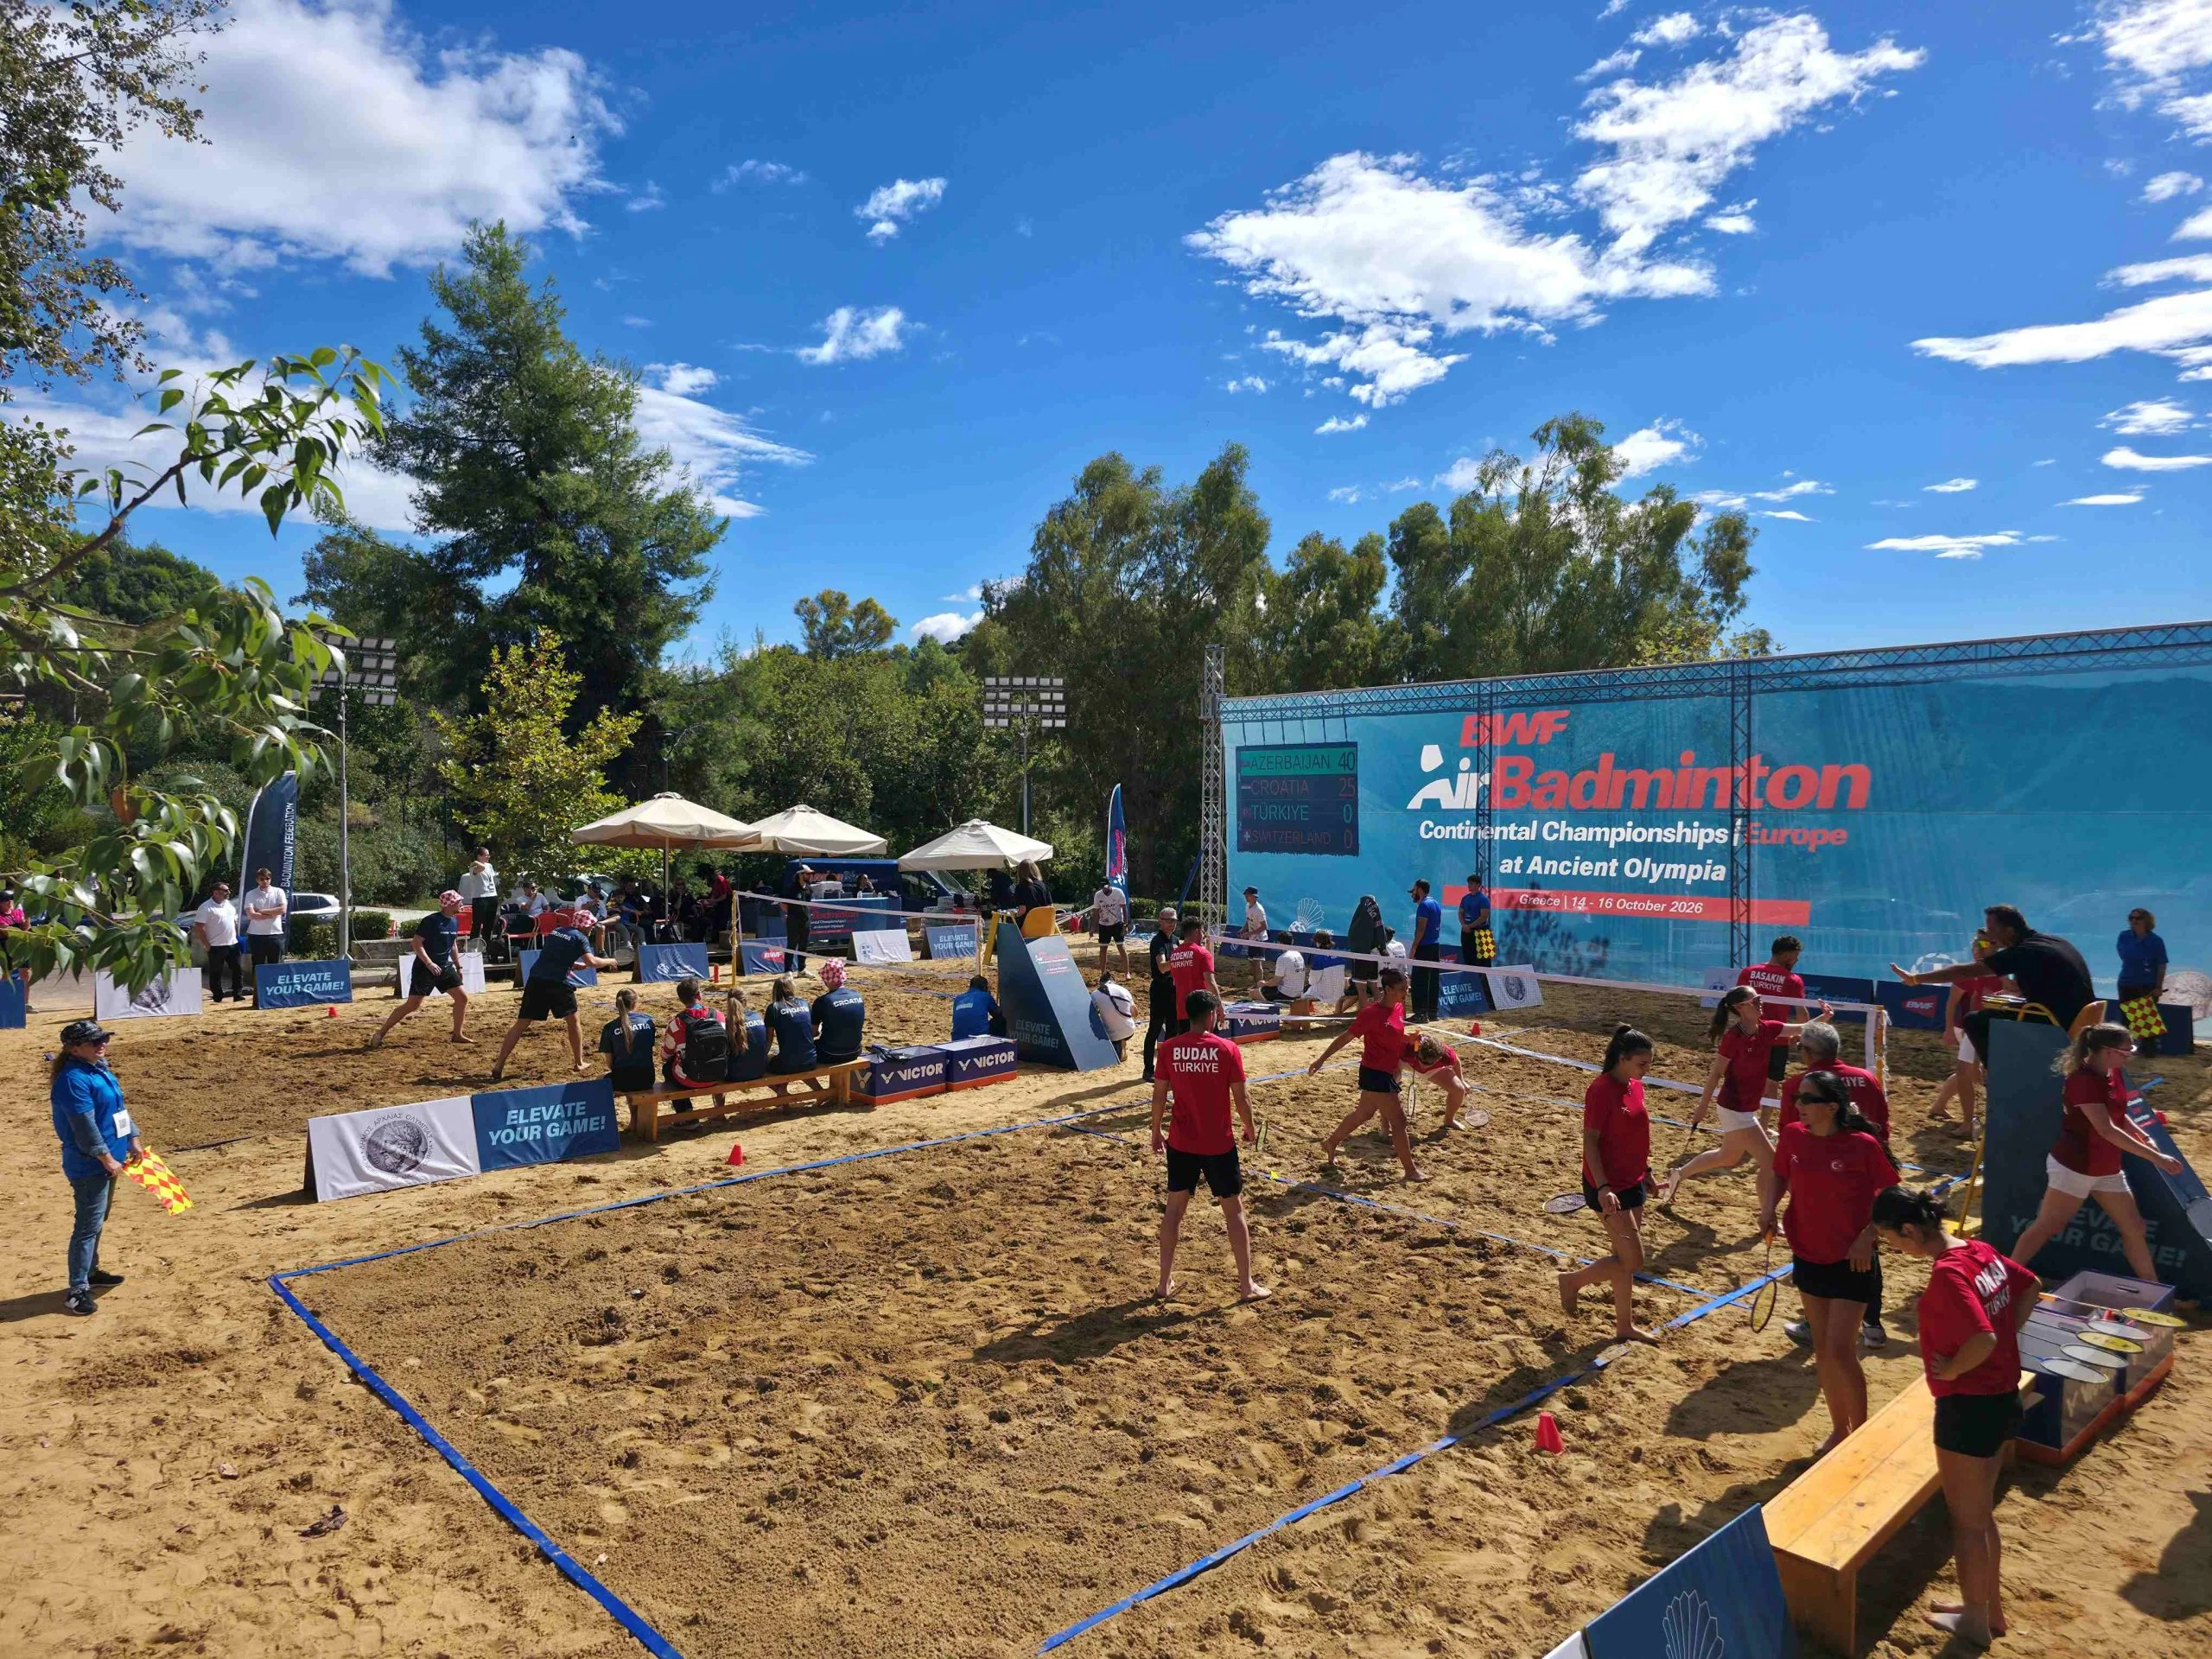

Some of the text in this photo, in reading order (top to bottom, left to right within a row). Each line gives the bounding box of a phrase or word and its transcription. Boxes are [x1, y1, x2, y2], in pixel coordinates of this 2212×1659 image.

[1459, 709, 1571, 747] BWF
[1250, 752, 1356, 771] AZERBAIJAN 40
[1251, 777, 1356, 797] CROATIA 25
[1343, 804, 1353, 823] 0
[285, 802, 295, 845] FEDERATION
[1251, 830, 1353, 849] SWITZERLAND 0
[1420, 820, 1538, 841] Continental
[1541, 821, 1729, 850] Championships
[1747, 822, 1848, 852] Europe
[280, 846, 293, 887] BADMINTON
[1499, 855, 1726, 885] at Ancient Olympia
[1519, 893, 1560, 907] Greece
[1572, 896, 1586, 908] 14
[1598, 898, 1613, 909] 16
[1616, 898, 1667, 912] October
[1669, 900, 1704, 914] 2026
[933, 941, 954, 950] YOUR
[939, 934, 969, 943] ELEVATE
[277, 972, 332, 984] ELEVATE
[1750, 970, 1785, 984] BASAKIN
[266, 981, 344, 995] YOUR GAME!
[1442, 982, 1472, 995] ELEVATE
[1748, 980, 1783, 993] TURKIYE
[833, 997, 864, 1007] CROATIA
[1439, 992, 1482, 1007] YOUR GAME!
[1904, 1001, 1935, 1010] BWF
[613, 1023, 651, 1035] CATIA
[1015, 1020, 1051, 1034] ELEVATE
[1032, 1033, 1059, 1049] GAME!
[973, 1051, 1015, 1069] VICTOR
[1173, 1047, 1219, 1061] BUDAK
[897, 1063, 944, 1081] VICTOR
[1173, 1062, 1219, 1073] TURKIYE
[506, 1101, 587, 1125] ELEVATE
[488, 1116, 606, 1146] YOUR GAME!
